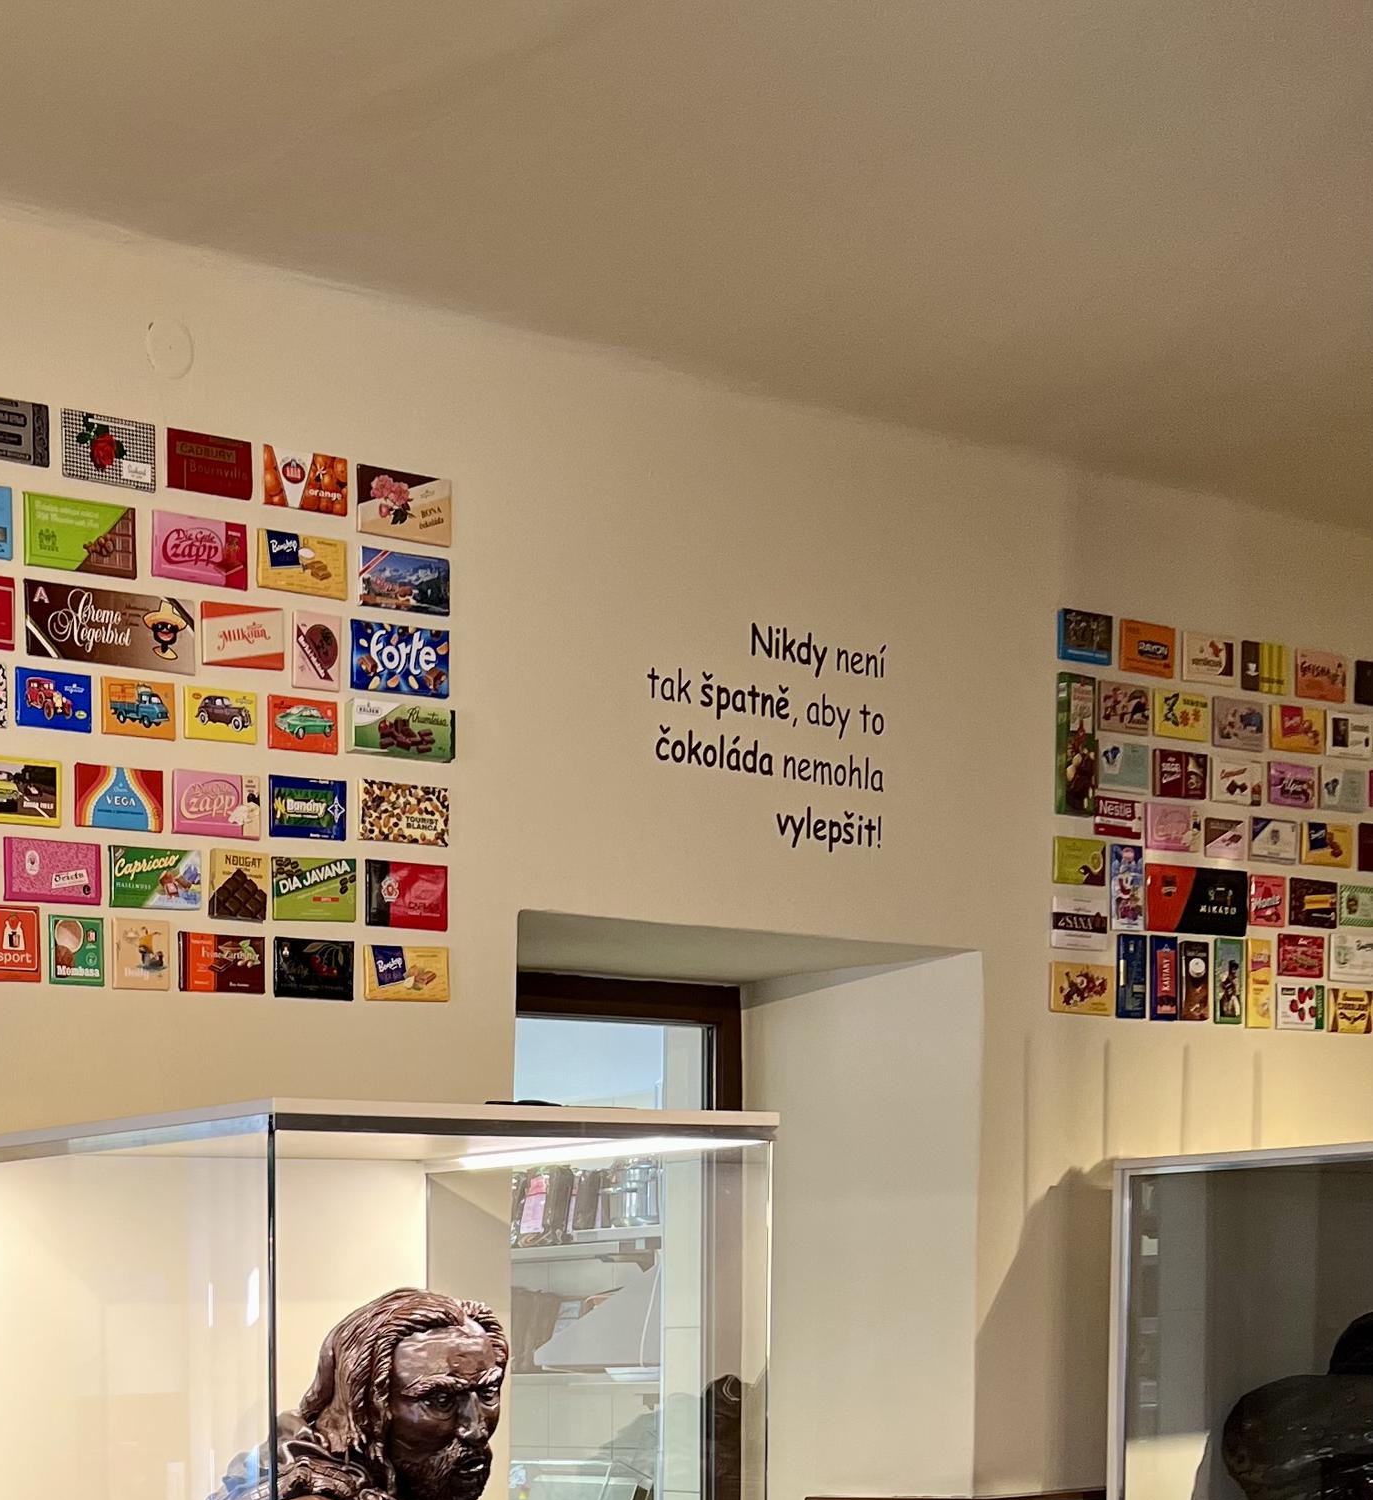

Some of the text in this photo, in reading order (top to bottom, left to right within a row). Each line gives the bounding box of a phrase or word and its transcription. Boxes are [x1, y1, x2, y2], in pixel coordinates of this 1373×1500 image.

[308, 488, 343, 501] orange
[370, 630, 437, 675] forte
[751, 622, 887, 678] Nikdy není
[647, 667, 885, 740] tak špatně, aby to
[655, 724, 884, 792] čokoláda nemohla
[106, 795, 136, 807] VEGA
[405, 816, 439, 826] TOURIST
[776, 806, 882, 853] vylepšit!
[115, 852, 180, 881] Capriccio
[225, 854, 263, 868] NOUGAT
[279, 860, 351, 894] DIA JAVANA
[56, 965, 100, 978] Mombasa
